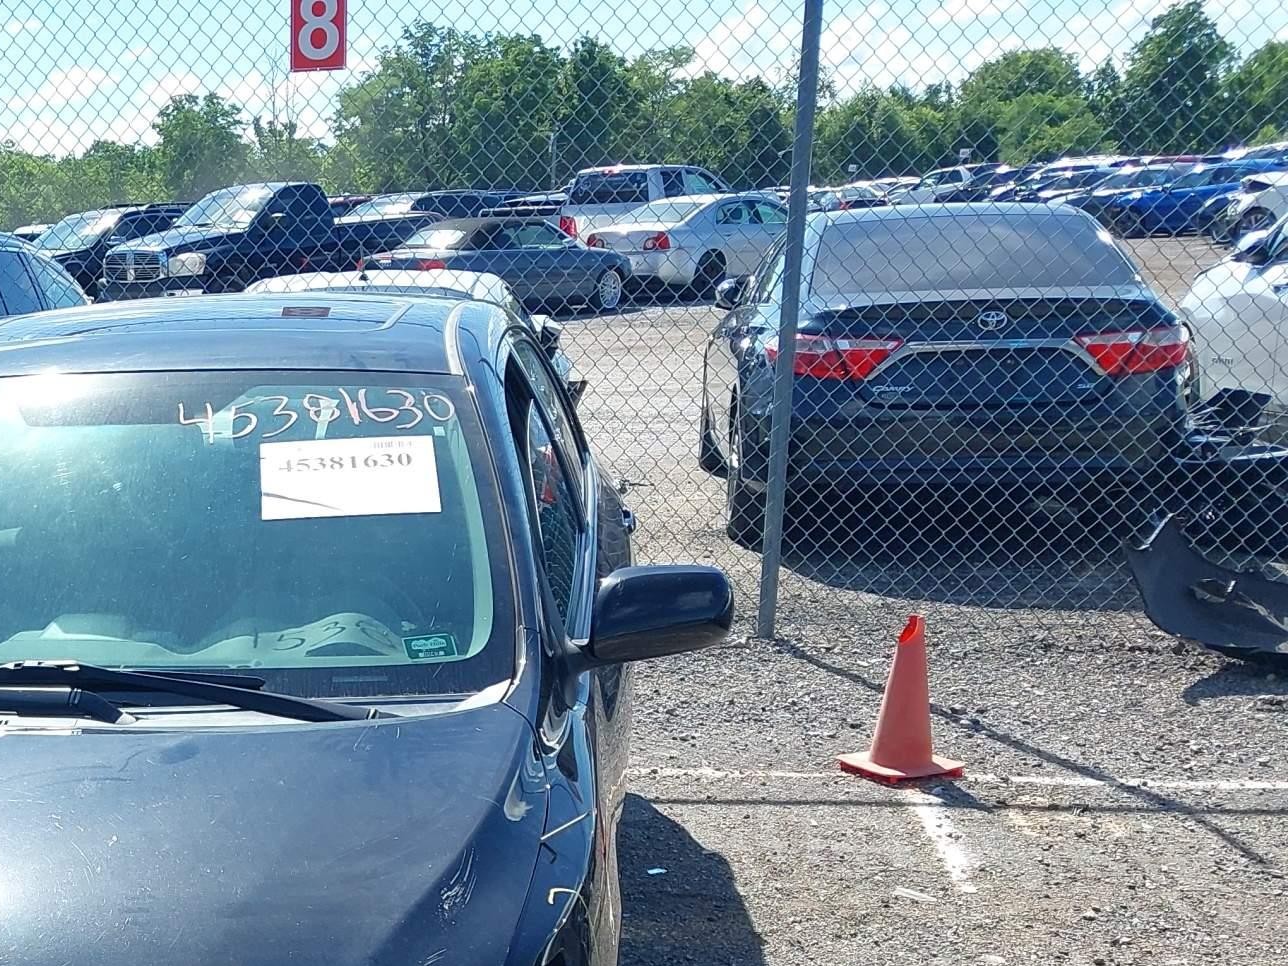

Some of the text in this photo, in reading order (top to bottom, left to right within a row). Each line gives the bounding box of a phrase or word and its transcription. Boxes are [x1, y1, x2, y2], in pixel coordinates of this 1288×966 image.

[298, 0, 340, 61] 8
[178, 387, 456, 445] 45381630
[278, 451, 413, 472] 45381630
